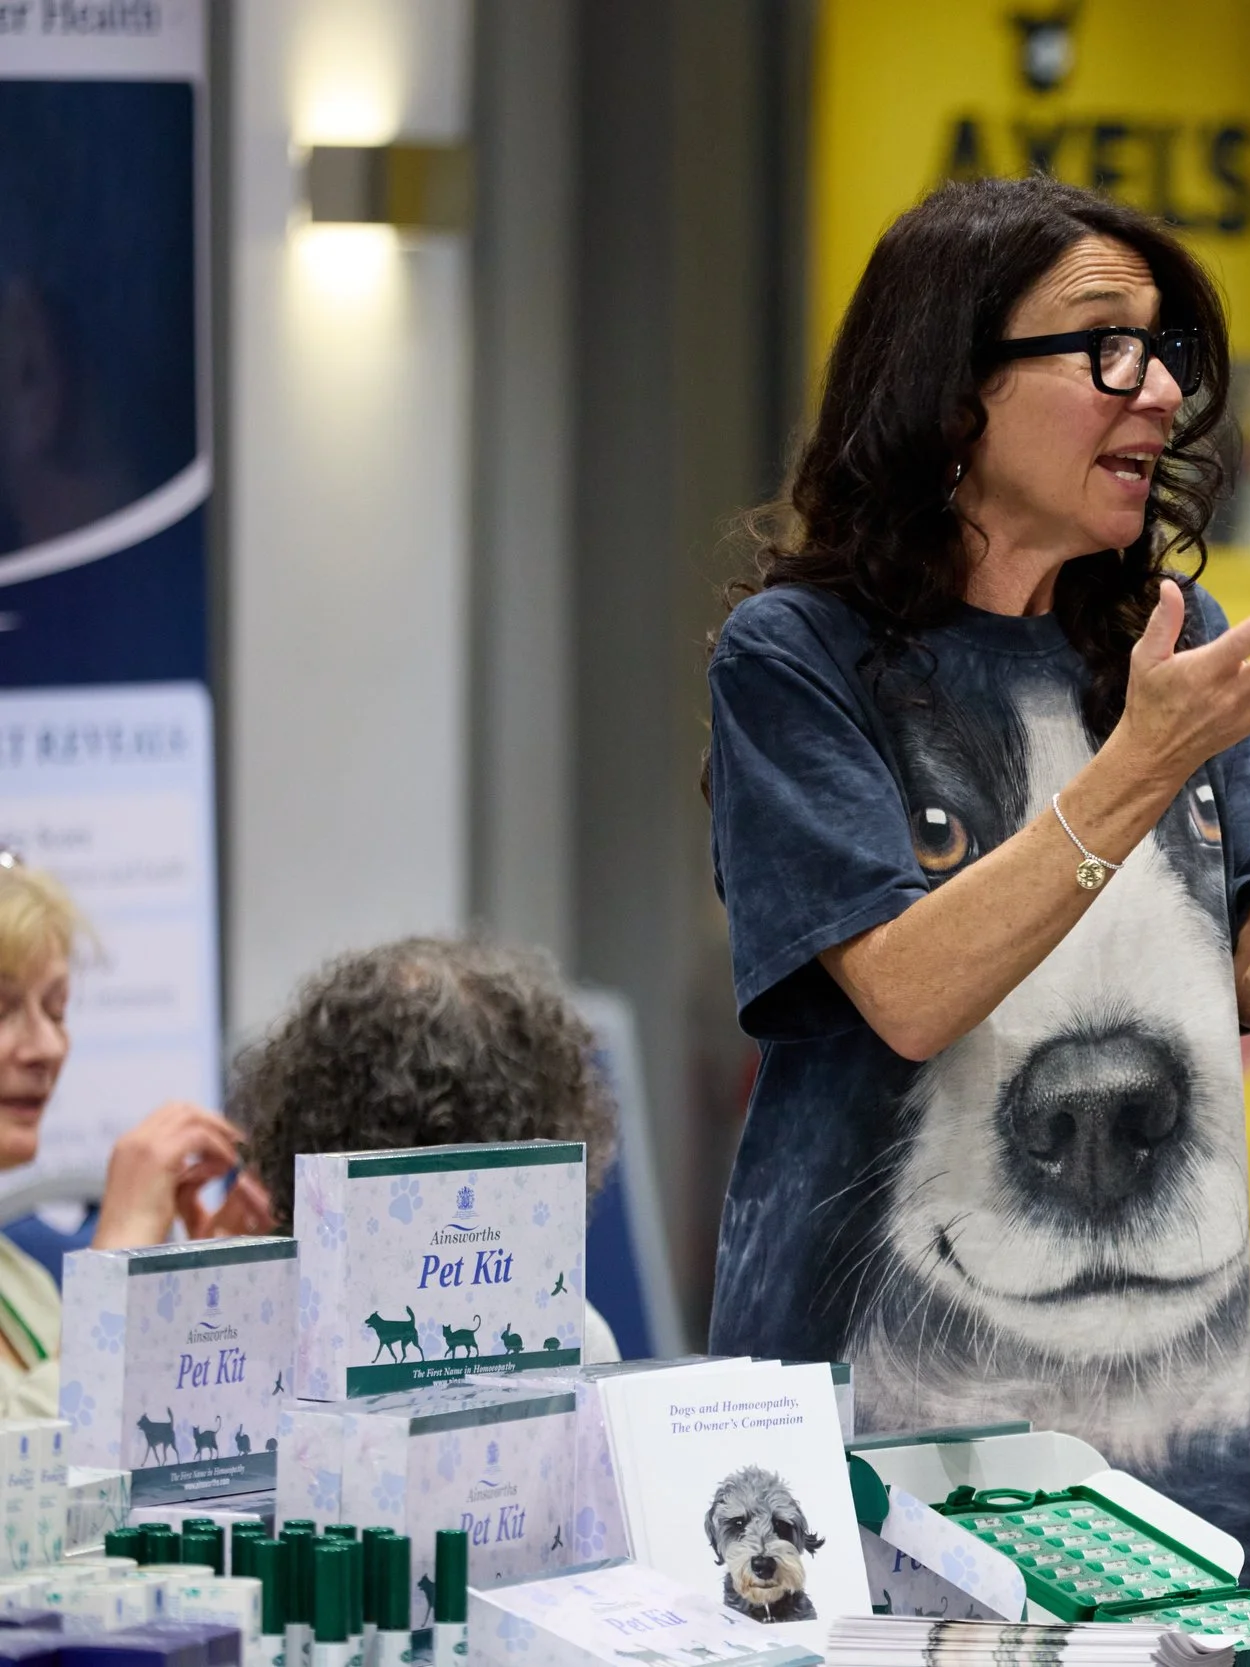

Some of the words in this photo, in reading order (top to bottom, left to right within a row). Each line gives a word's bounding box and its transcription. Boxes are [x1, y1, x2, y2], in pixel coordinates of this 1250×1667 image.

[429, 1226, 501, 1246] Ainsworths
[417, 1254, 464, 1290] Pet
[470, 1248, 514, 1286] Kit
[186, 1324, 239, 1345] Ainsworths
[175, 1353, 212, 1390] Pet
[215, 1347, 247, 1386] Kit
[412, 1368, 425, 1379] The
[426, 1367, 442, 1378] First
[443, 1366, 463, 1376] Name
[464, 1365, 472, 1374] in
[669, 1404, 696, 1418] Dogs
[698, 1402, 719, 1415] and
[722, 1395, 799, 1413] Homoeopathy,
[671, 1422, 691, 1434] The
[694, 1417, 738, 1432] Owner's
[741, 1414, 804, 1430] Companion
[466, 1482, 518, 1503] Ainsworths
[460, 1512, 491, 1547] Pet
[495, 1503, 526, 1543] Kit
[604, 1617, 655, 1636] Pet
[640, 1608, 688, 1628] Kit
